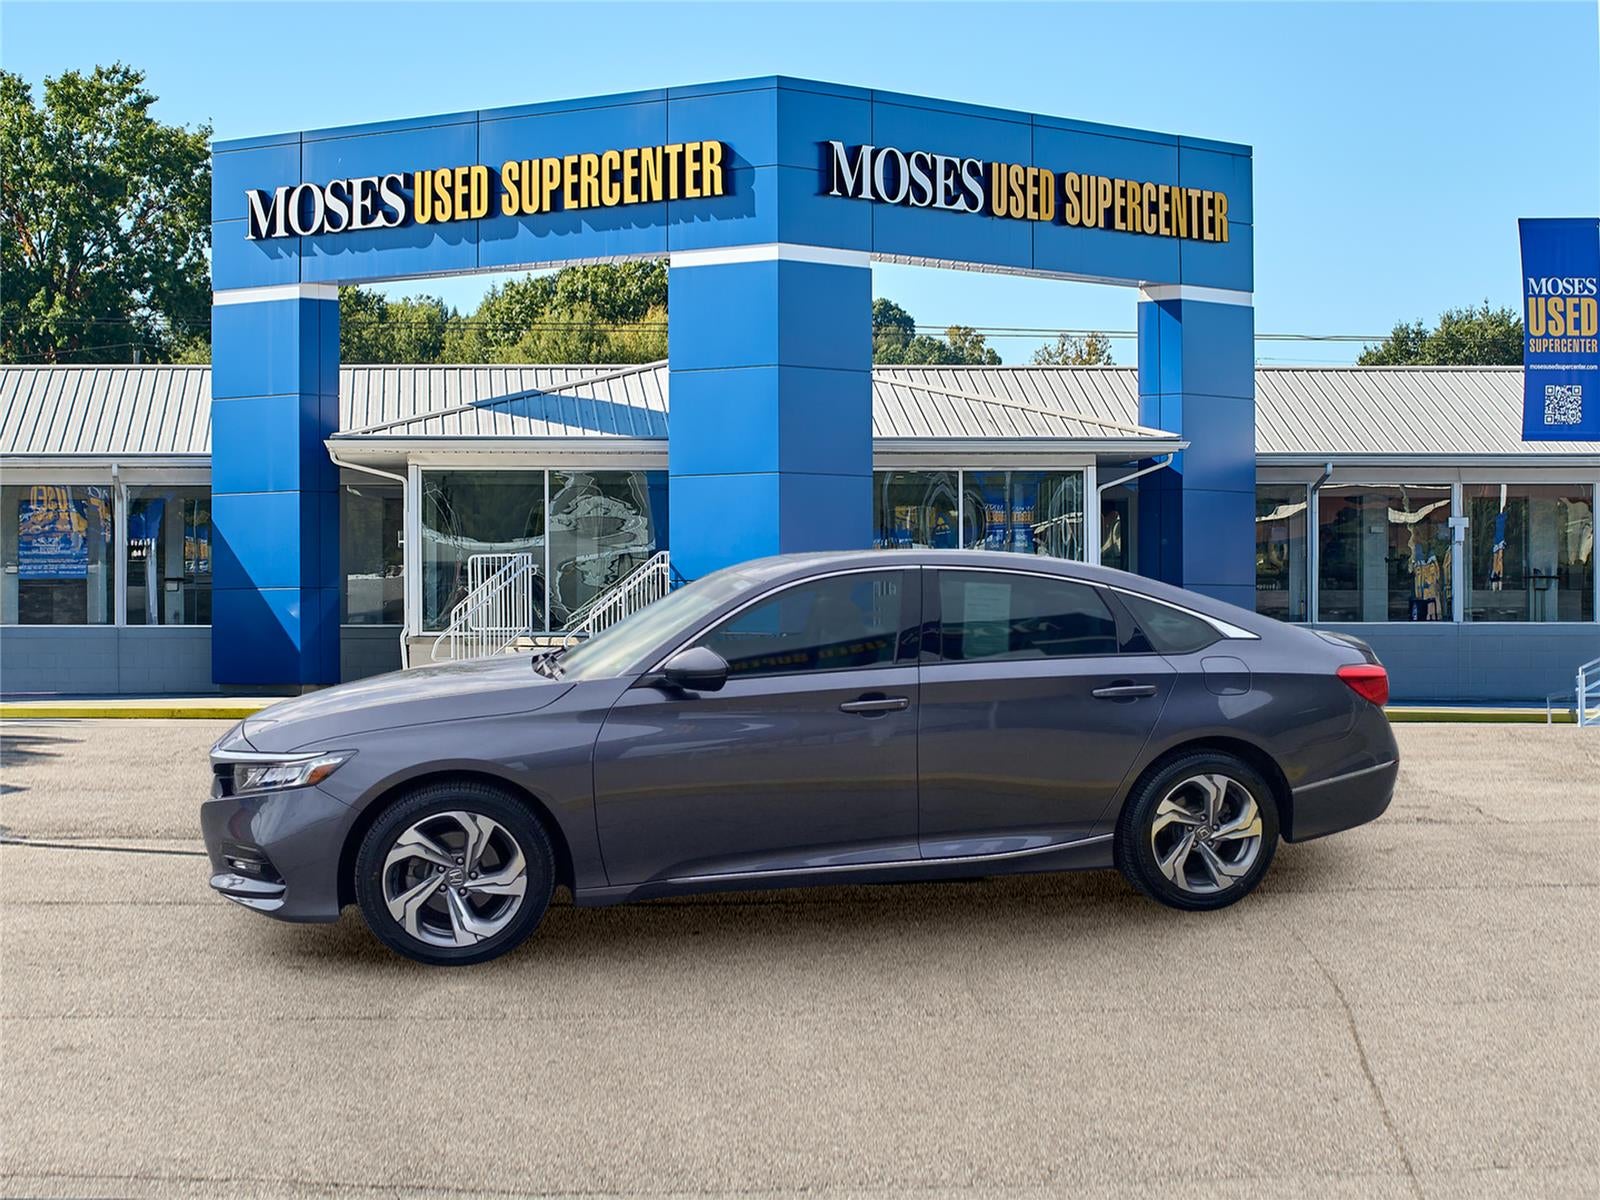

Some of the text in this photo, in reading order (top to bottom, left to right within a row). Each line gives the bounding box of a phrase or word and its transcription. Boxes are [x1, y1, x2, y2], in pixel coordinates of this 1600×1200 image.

[244, 140, 725, 241] MOSES USED SUPERCENTER
[828, 140, 1230, 243] MOSES USED SUPERCENTER
[1528, 277, 1598, 296] MOSES
[1528, 296, 1598, 337] USED
[1529, 338, 1598, 353] SUPERCENTER
